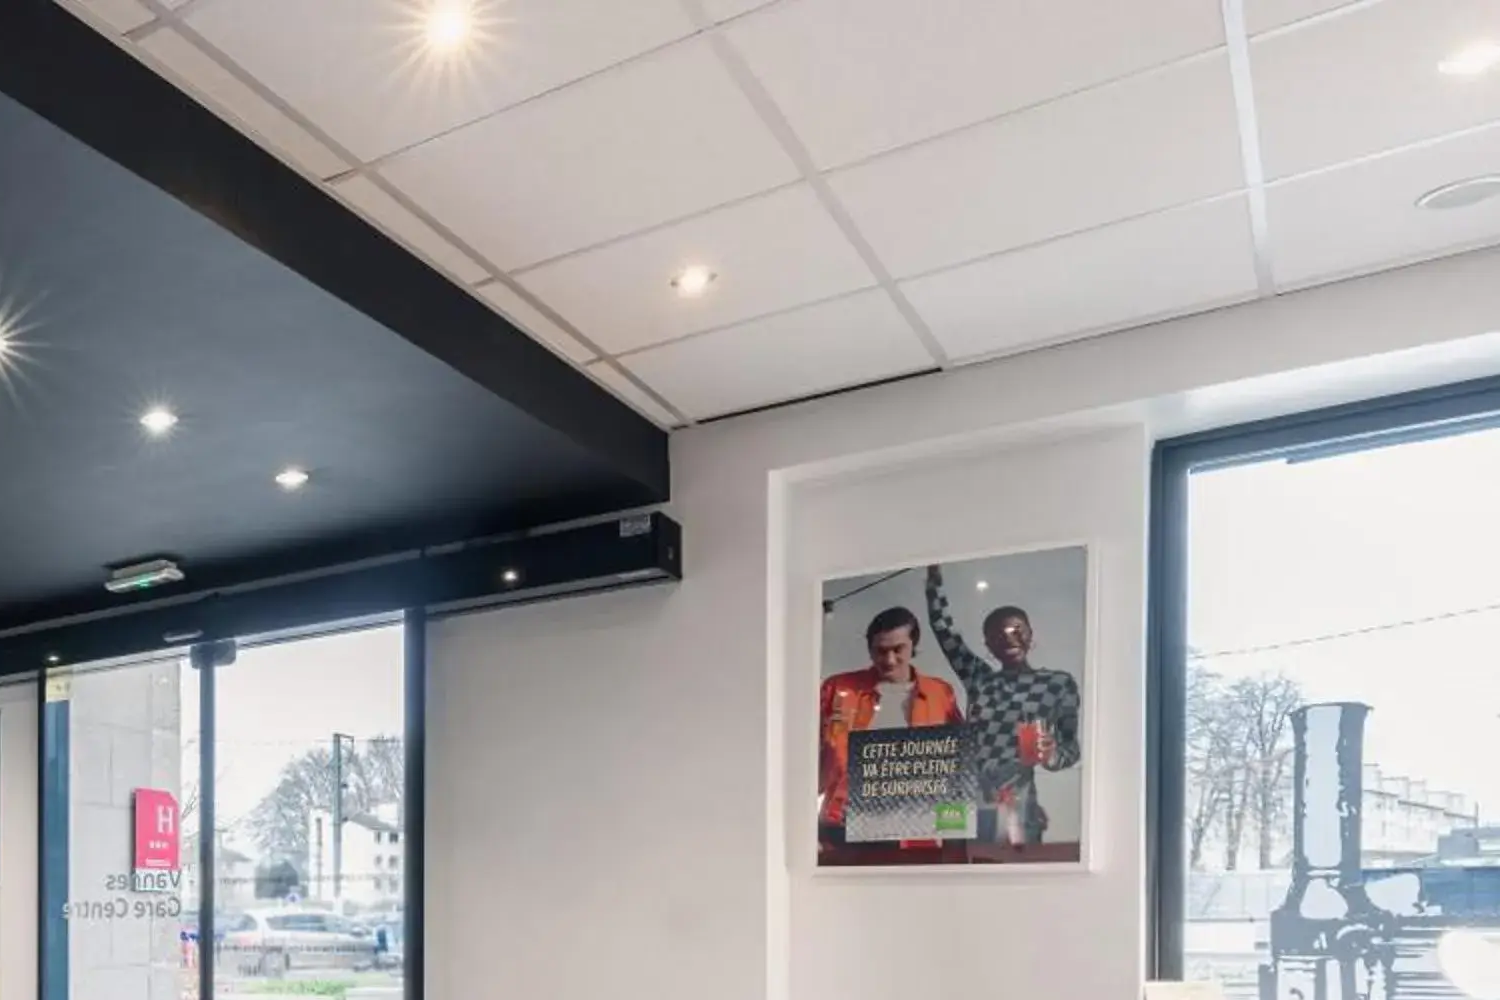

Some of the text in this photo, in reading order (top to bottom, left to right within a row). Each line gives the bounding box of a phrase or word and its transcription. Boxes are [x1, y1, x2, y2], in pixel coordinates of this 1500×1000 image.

[863, 736, 959, 758] CETTE JOURNÉE
[863, 763, 879, 777] VA
[913, 759, 957, 775] PLEINE
[862, 779, 948, 797] DE SURPRISES
[157, 804, 175, 833] H
